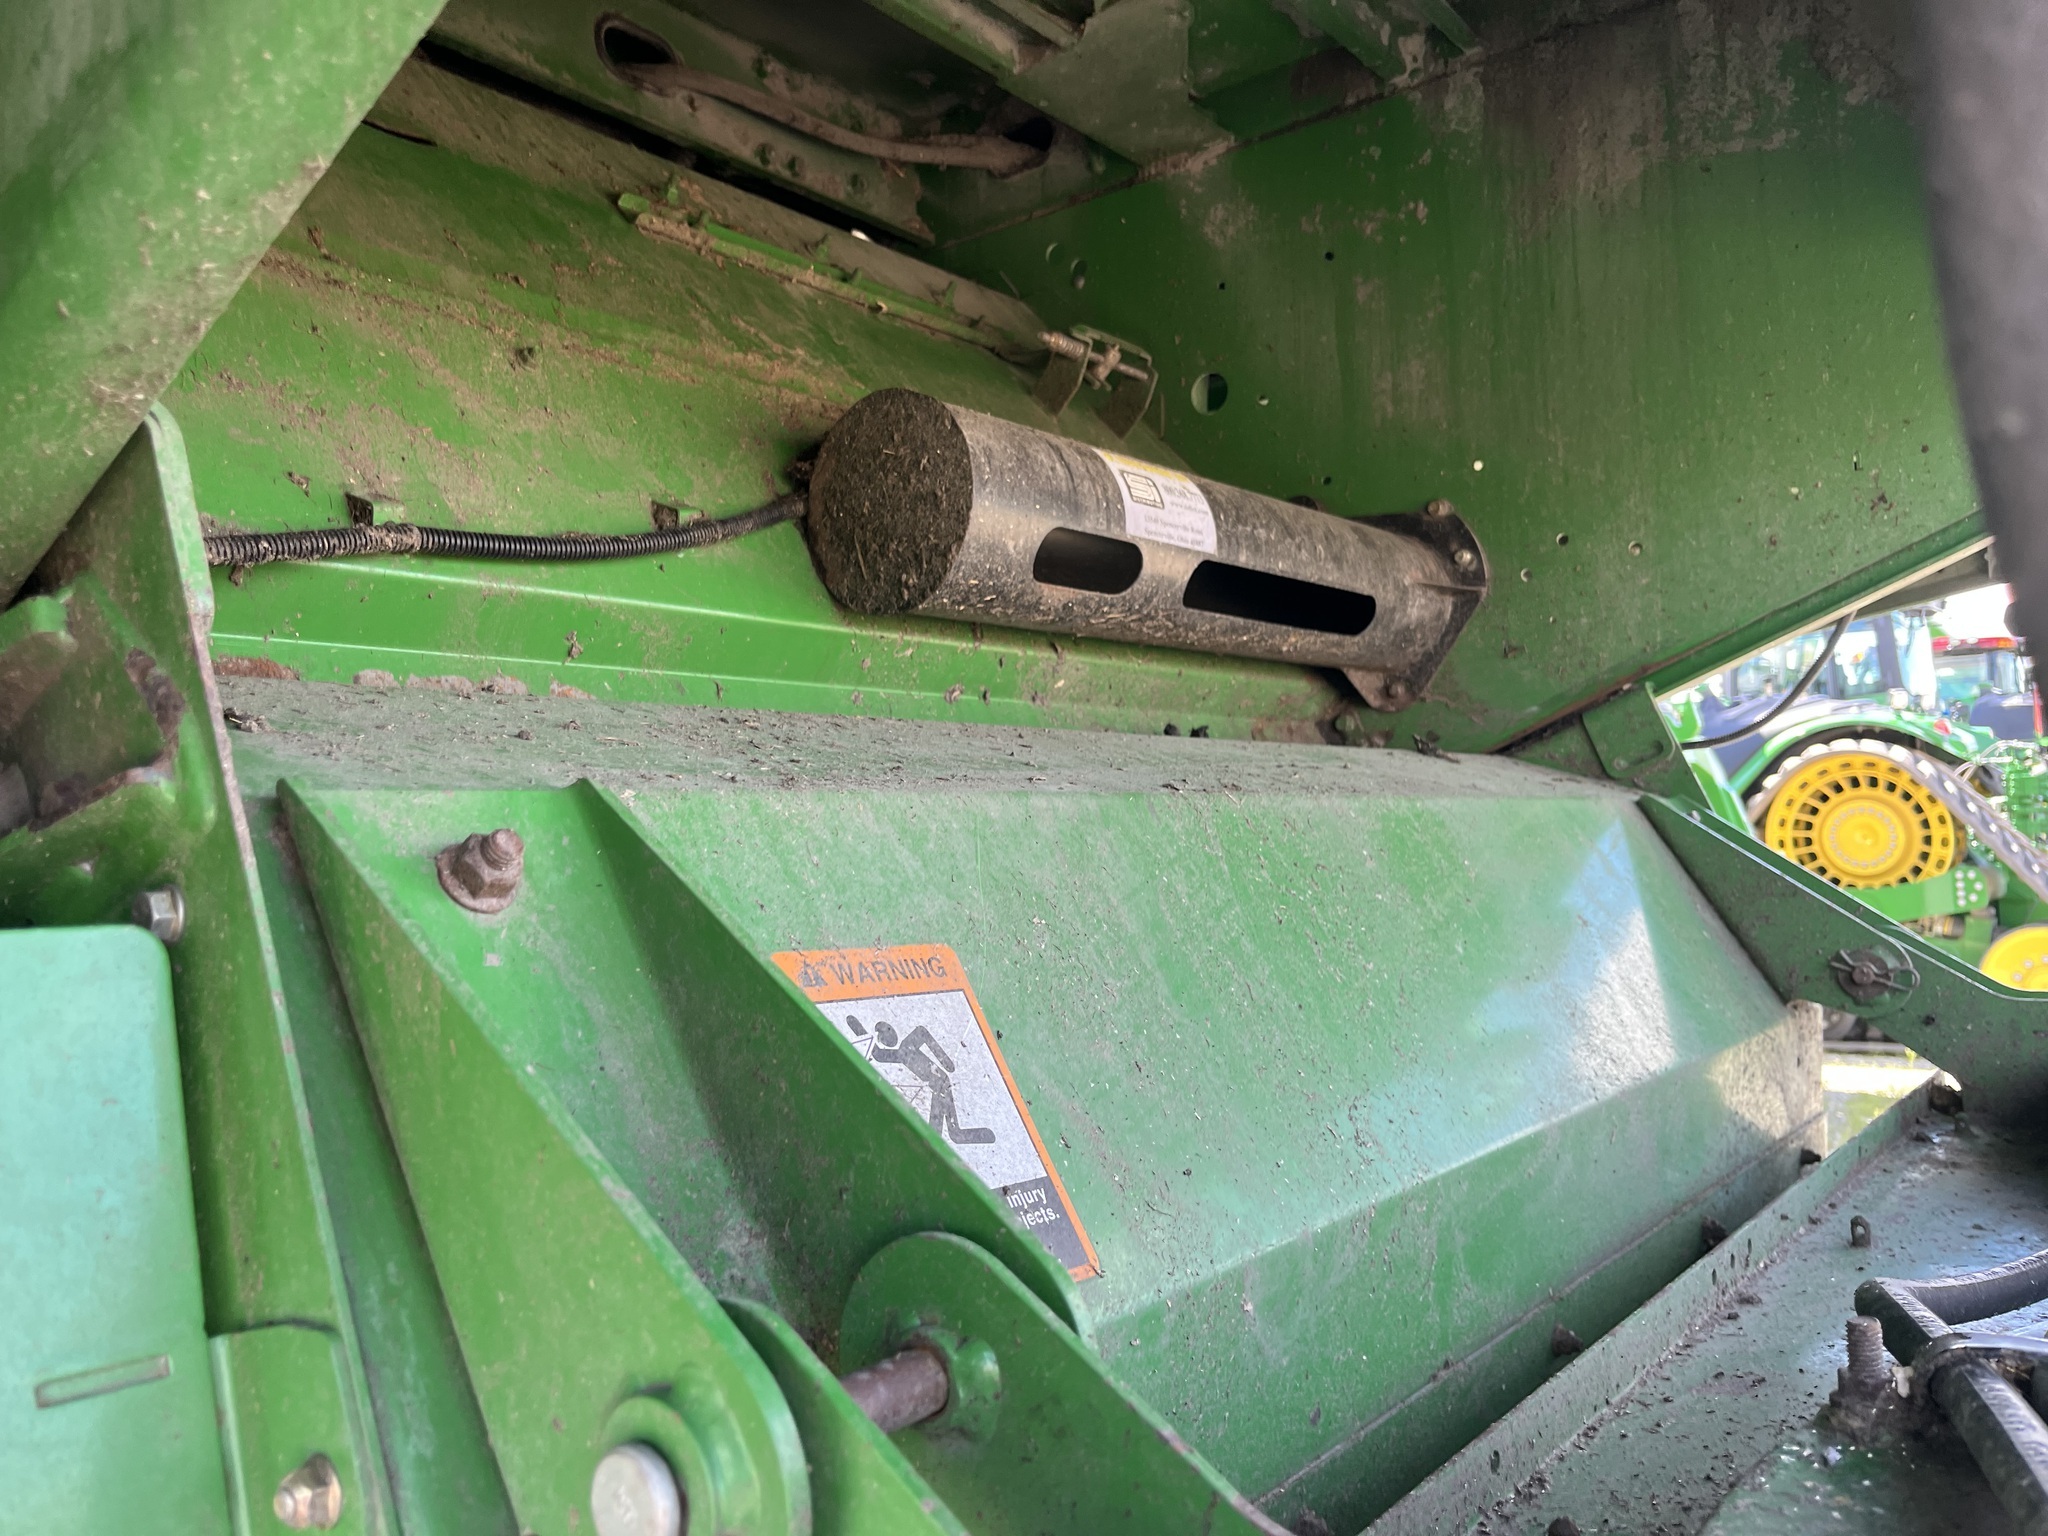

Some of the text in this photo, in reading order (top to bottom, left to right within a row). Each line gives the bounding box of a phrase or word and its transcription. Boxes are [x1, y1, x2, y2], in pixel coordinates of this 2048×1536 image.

[828, 956, 948, 986] WARNING
[1006, 1187, 1047, 1209] injury
[1018, 1207, 1061, 1230] jects.
